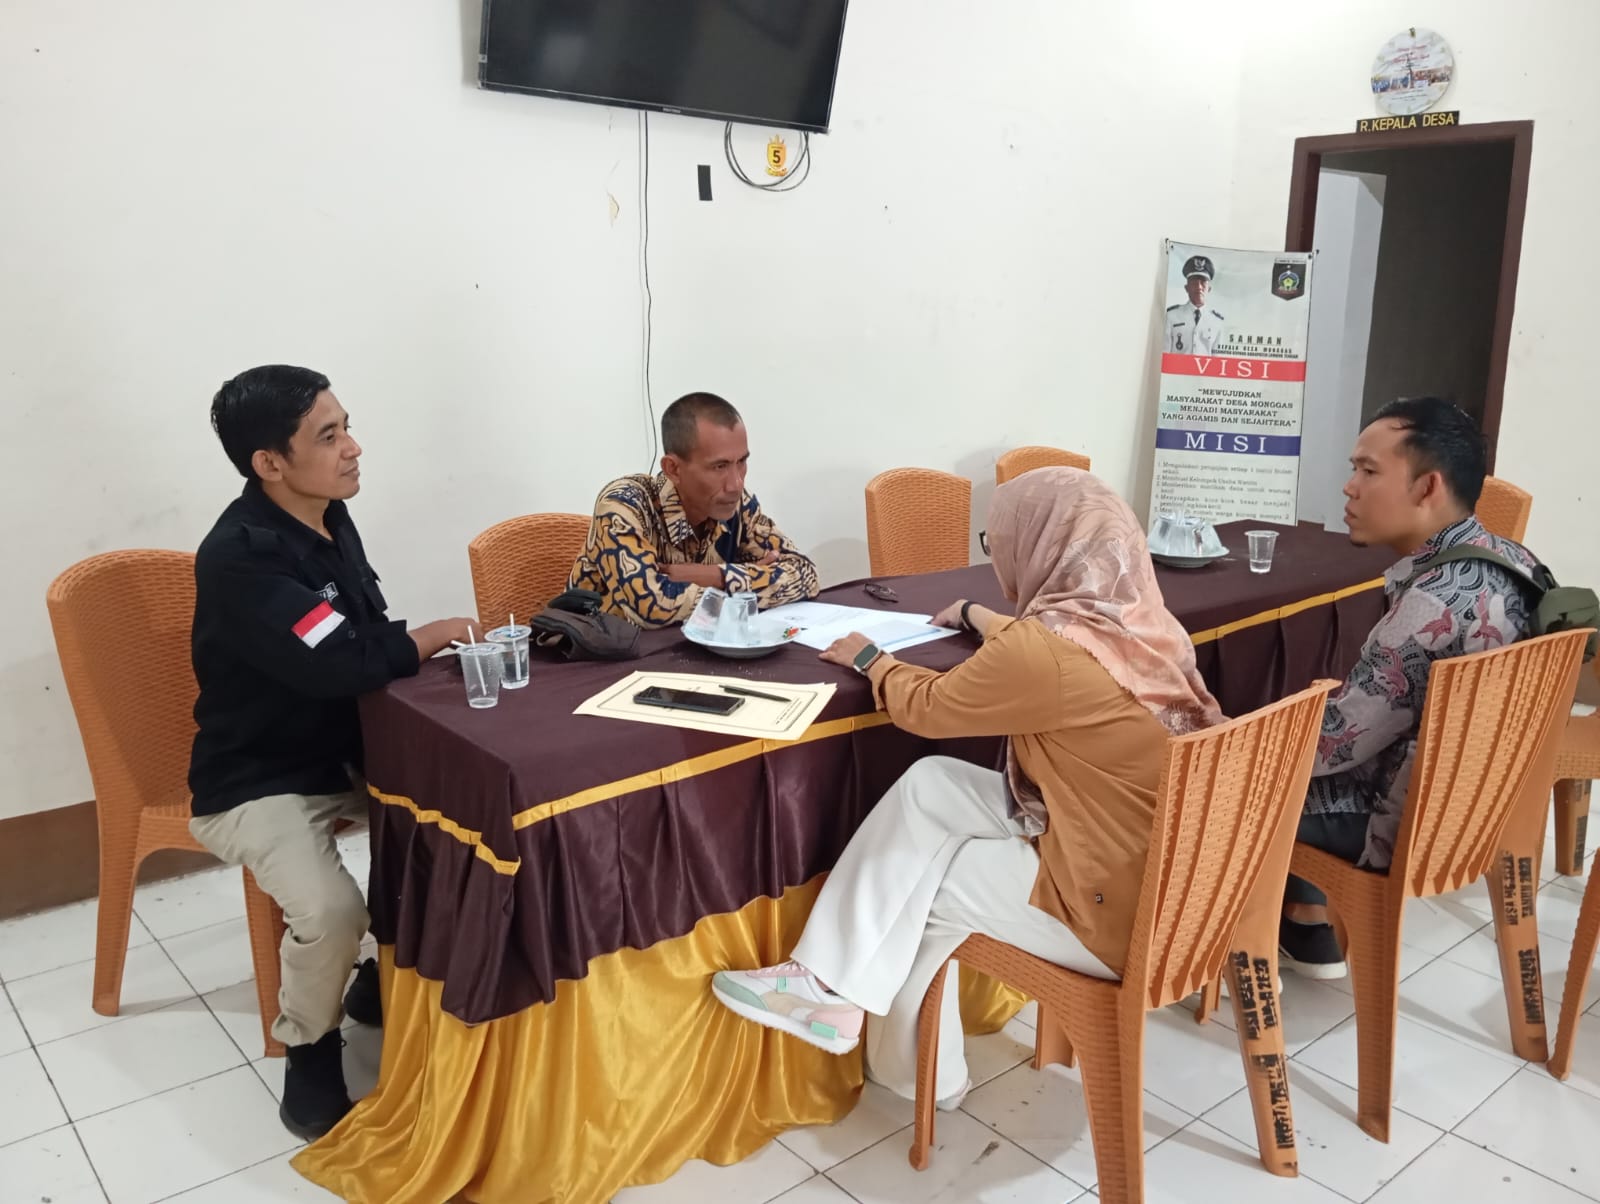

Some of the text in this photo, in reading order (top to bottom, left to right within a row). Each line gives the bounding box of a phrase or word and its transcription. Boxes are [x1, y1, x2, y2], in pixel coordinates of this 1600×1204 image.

[1422, 112, 1455, 127] DESA
[772, 150, 781, 164] 5
[1229, 334, 1282, 345] SAHMAN
[1194, 357, 1271, 379] VISI
[1166, 395, 1293, 409] MASYARAKAT DESA MONGGAS
[1180, 404, 1278, 417] MENJADI MASYARAKAT
[1161, 412, 1184, 420] YANG
[1186, 414, 1219, 423] AGAMIS
[1221, 417, 1239, 425] DAN
[1184, 432, 1267, 453] MISI
